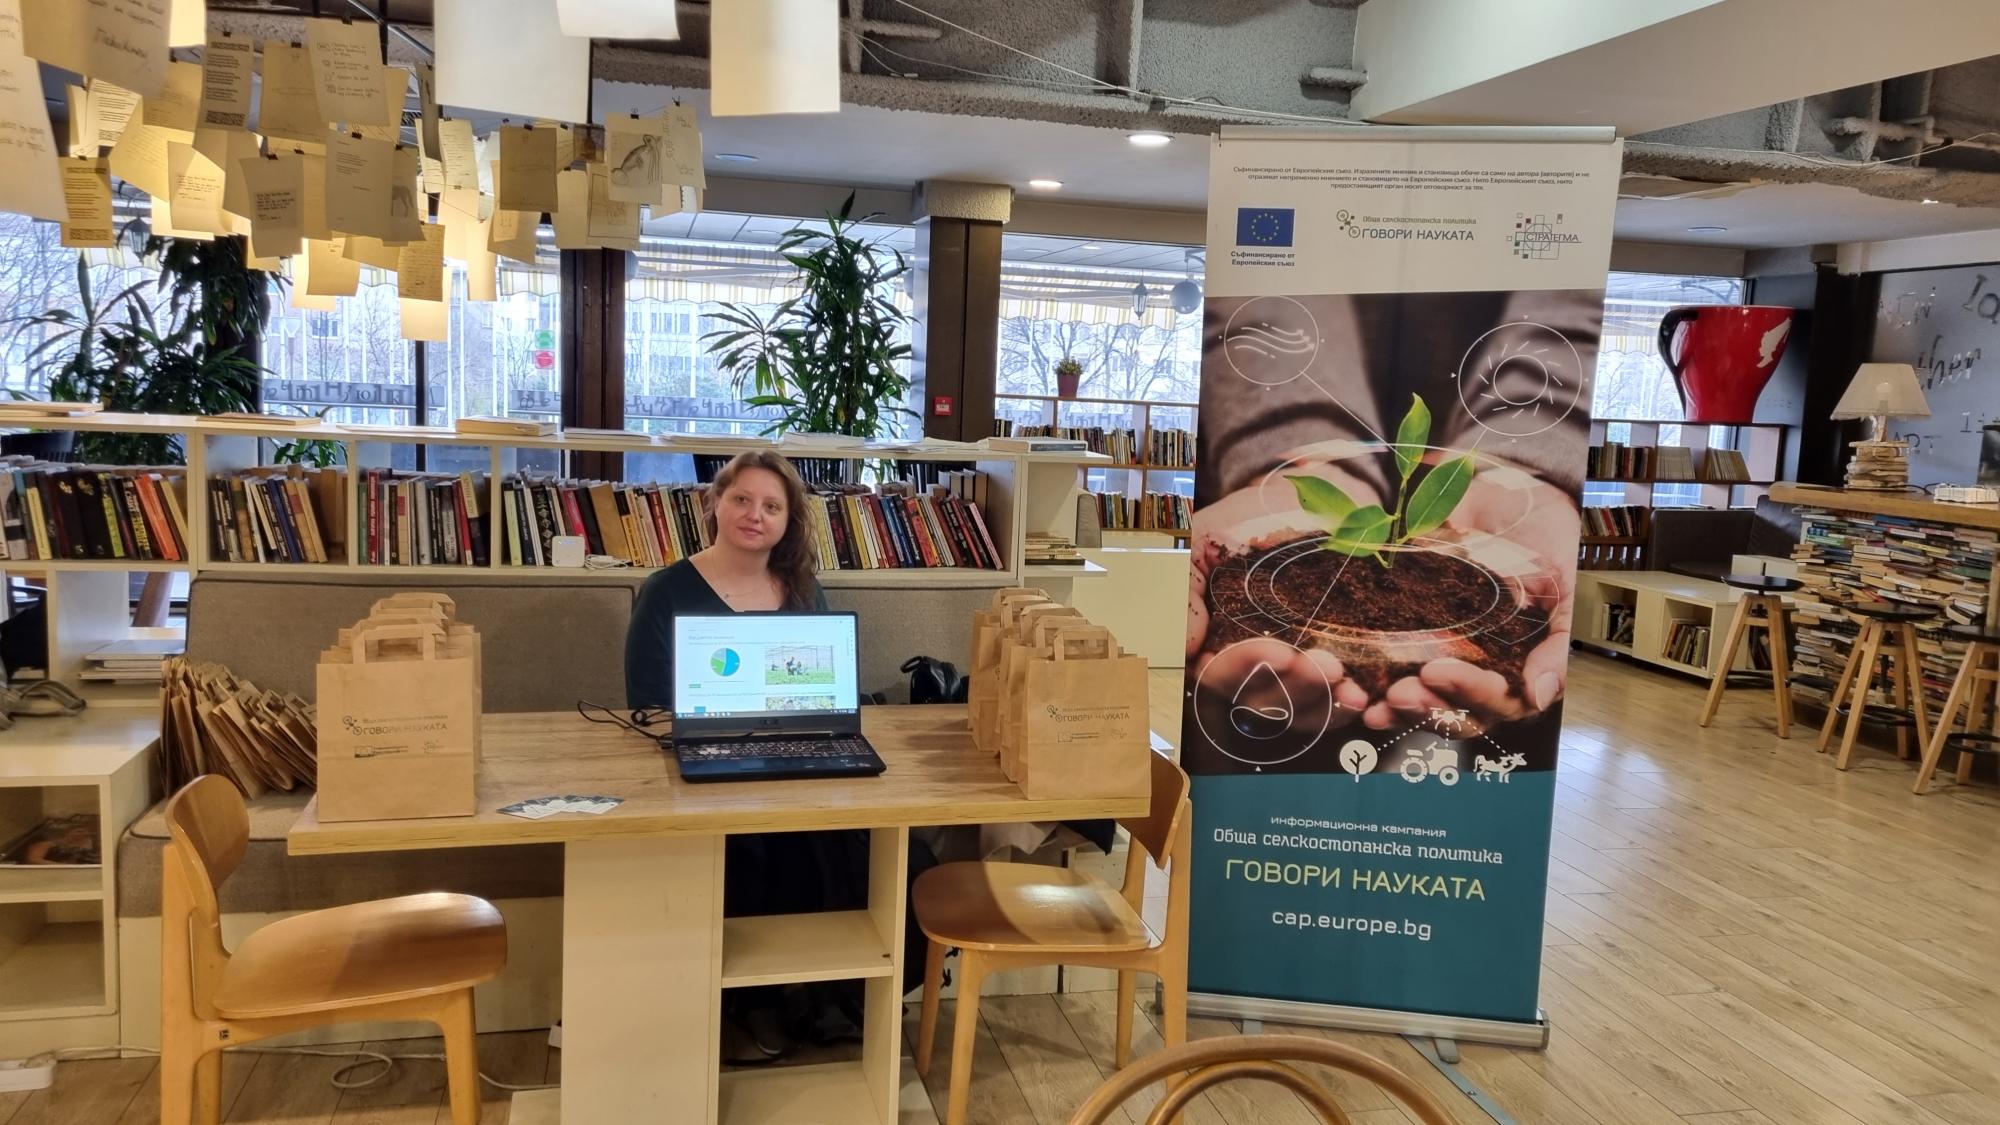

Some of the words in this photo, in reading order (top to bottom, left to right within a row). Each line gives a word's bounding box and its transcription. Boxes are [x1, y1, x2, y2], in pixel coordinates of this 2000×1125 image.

[1382, 216, 1442, 224] селскостопанска
[1442, 217, 1477, 225] политика
[1362, 228, 1412, 240] ГОВОРИ
[1416, 229, 1474, 241] НАУКАТА
[1230, 250, 1286, 259] Съфинансирано
[1232, 258, 1276, 268] Европейския
[1270, 816, 1378, 833] информационна
[1382, 825, 1447, 838] кампания
[1213, 828, 1257, 846] Обща
[1262, 833, 1413, 858] селскостопанска
[1418, 844, 1503, 865] политика
[1226, 859, 1341, 889] ГОВОРИ
[1352, 869, 1486, 901] НАУКАТА
[1272, 910, 1433, 941] cap.europe.bg
